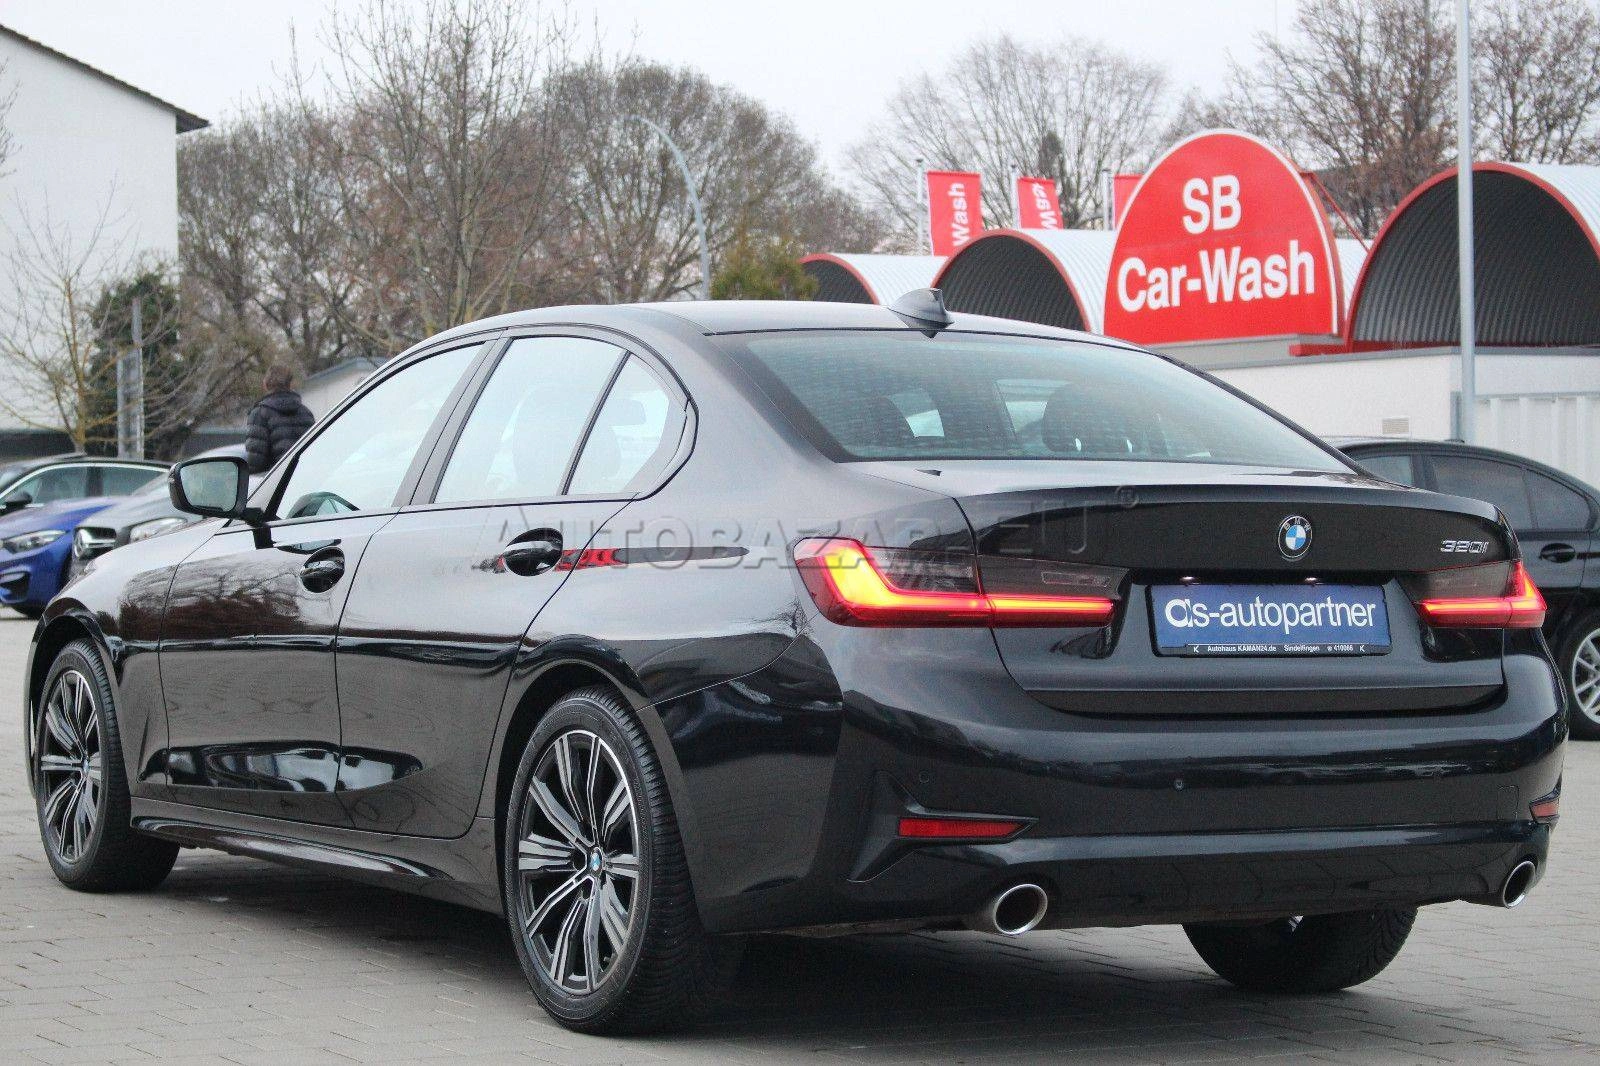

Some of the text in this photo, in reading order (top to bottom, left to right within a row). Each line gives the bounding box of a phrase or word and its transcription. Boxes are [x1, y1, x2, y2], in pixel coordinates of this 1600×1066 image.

[948, 182, 971, 247] Wash
[1181, 174, 1242, 236] SB
[1116, 239, 1316, 314] Car-Wash
[1440, 539, 1490, 554] 320i
[1164, 595, 1376, 635] as-autopartner
[1283, 644, 1320, 653] Sindelfingen
